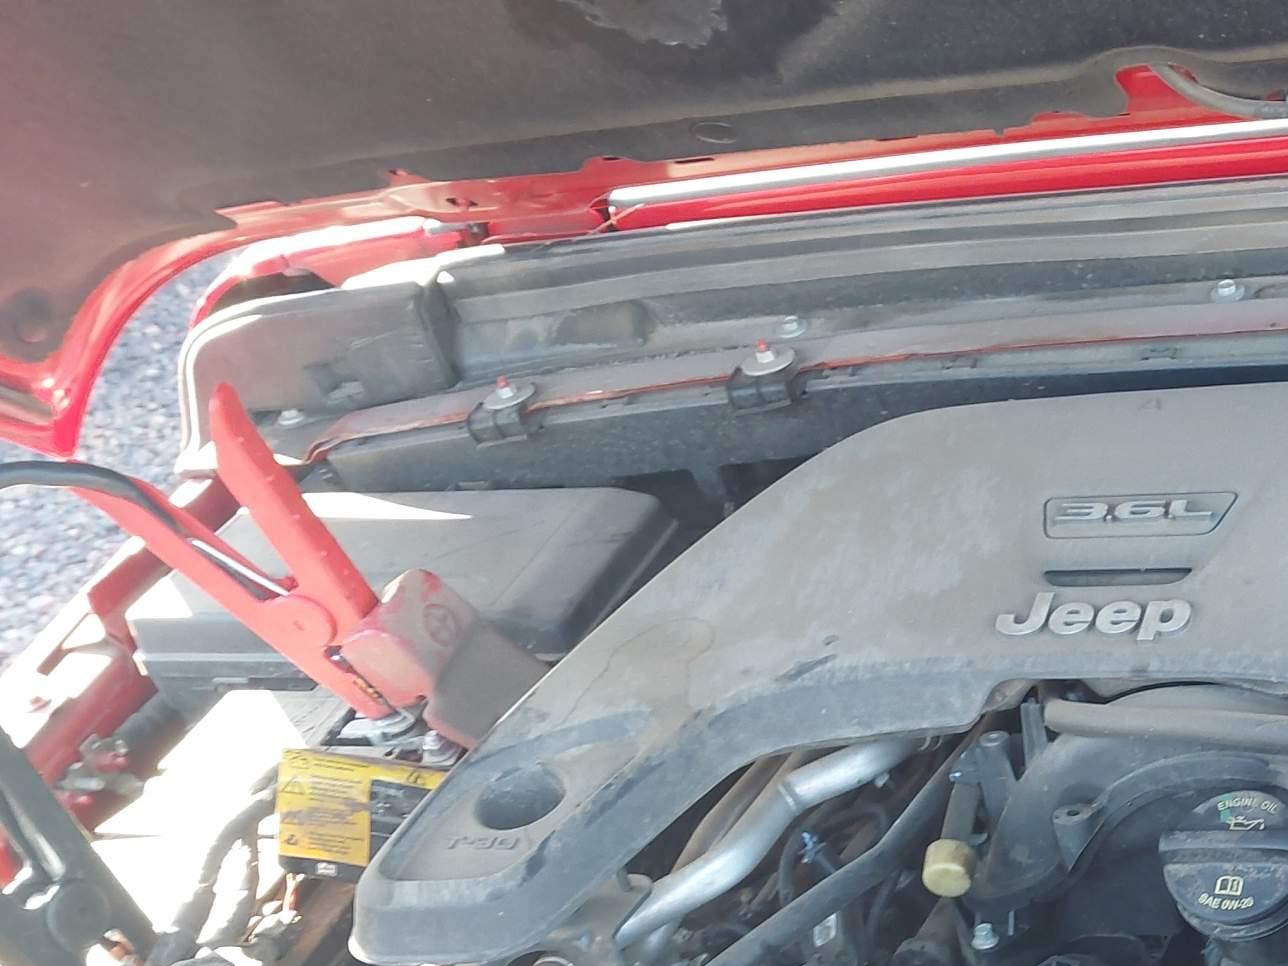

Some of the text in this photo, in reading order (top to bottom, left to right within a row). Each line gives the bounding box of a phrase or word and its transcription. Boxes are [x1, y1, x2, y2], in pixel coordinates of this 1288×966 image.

[1054, 499, 1213, 523] 3.6L
[995, 591, 1192, 641] Jeep
[1217, 798, 1280, 814] ENGINE OIL
